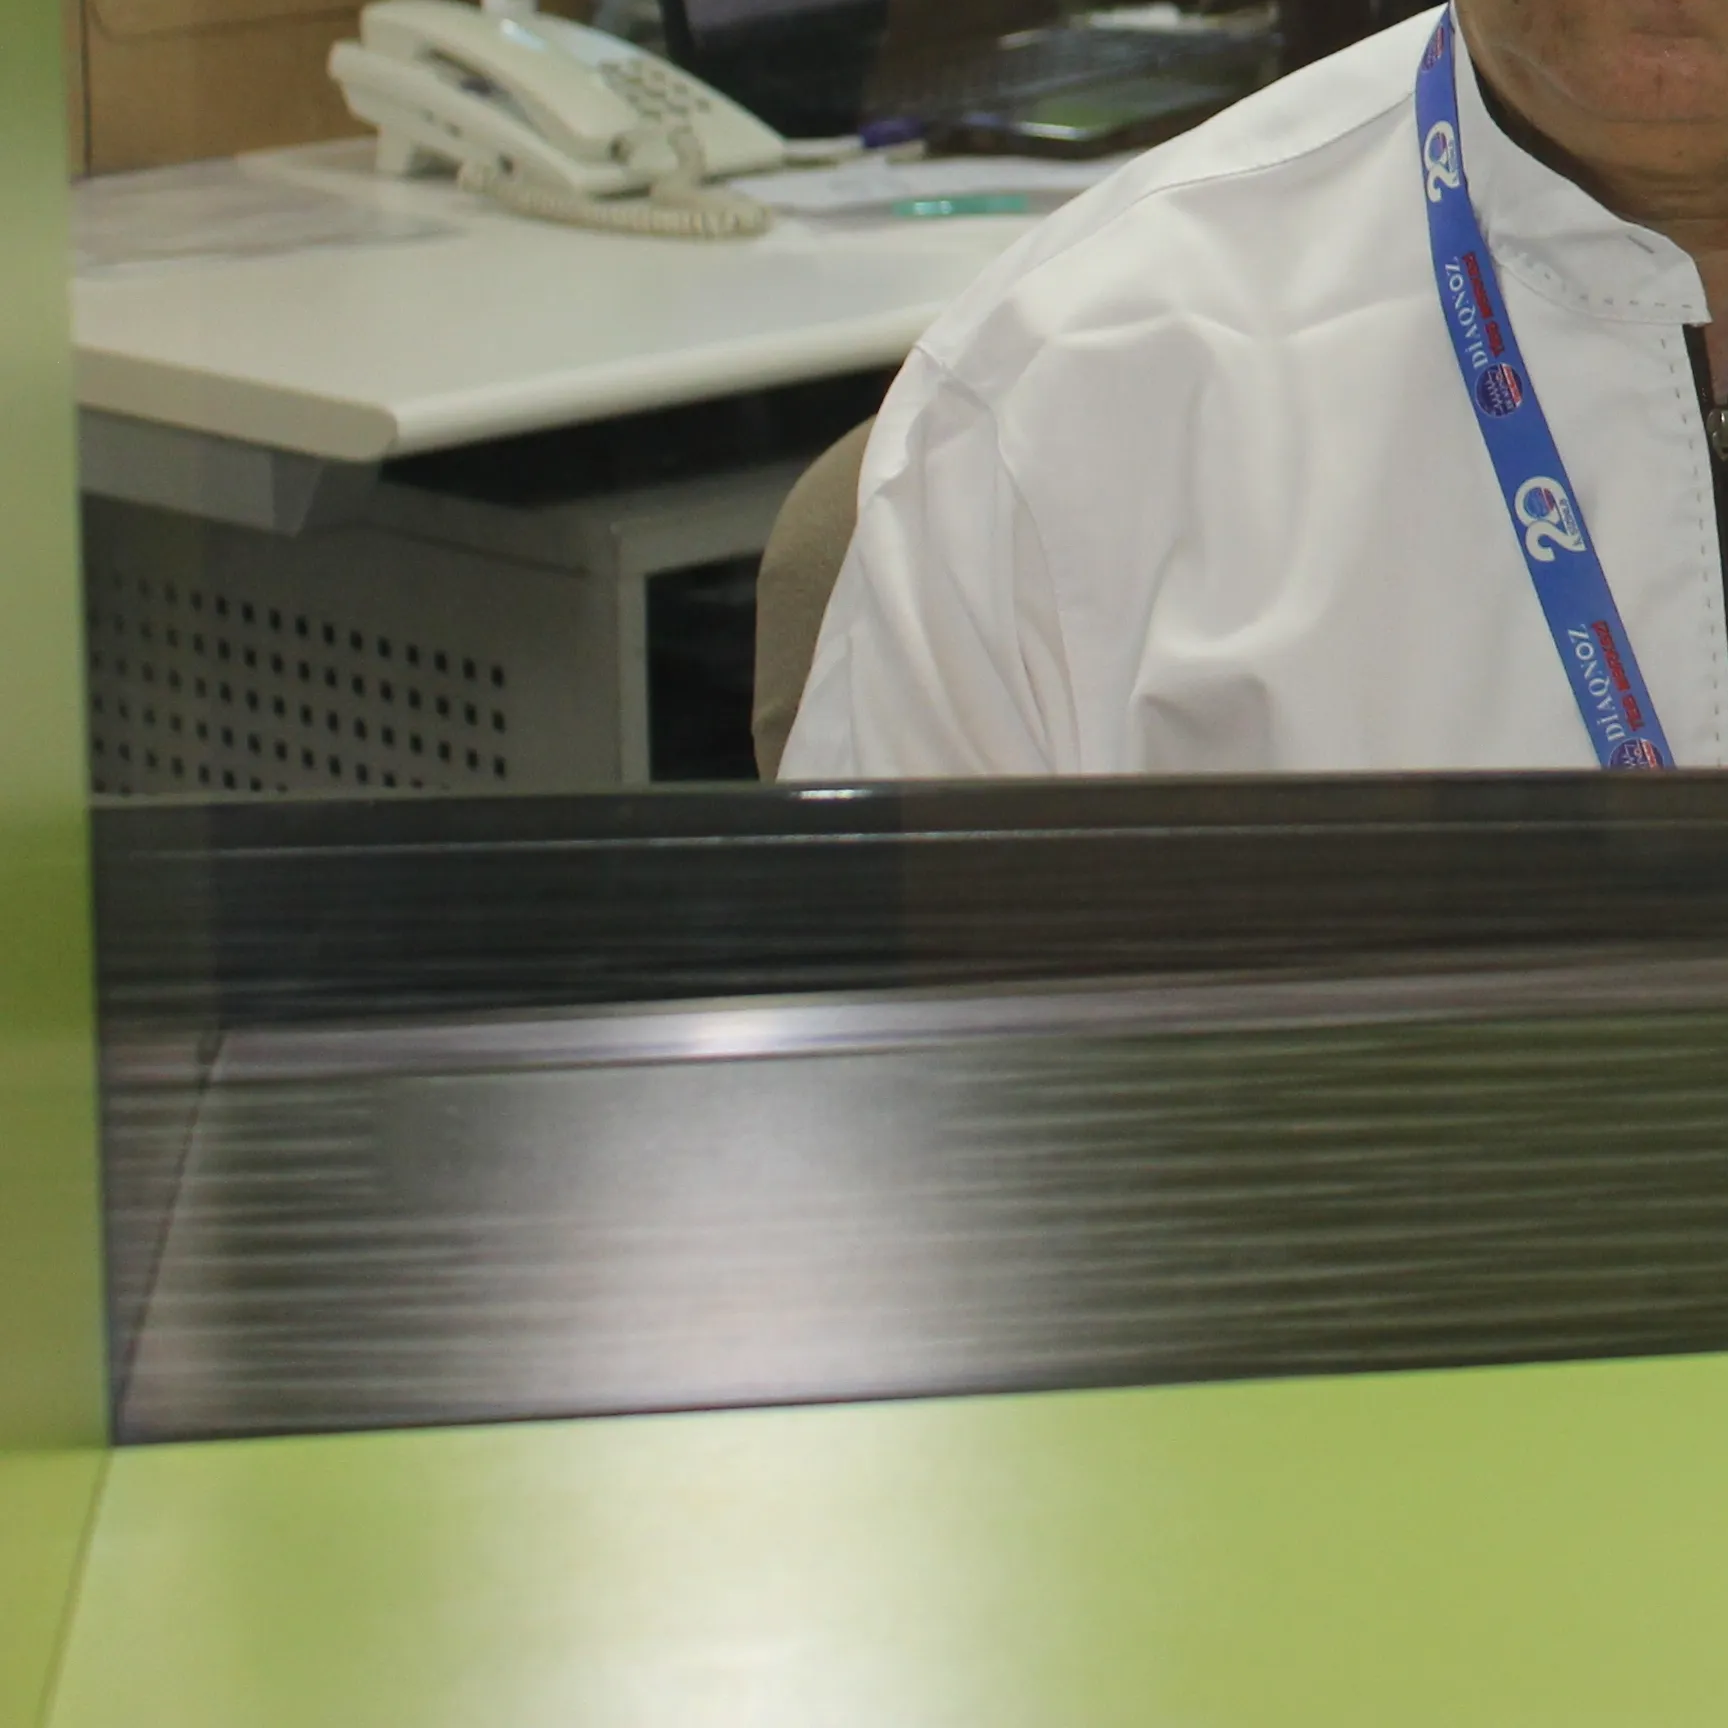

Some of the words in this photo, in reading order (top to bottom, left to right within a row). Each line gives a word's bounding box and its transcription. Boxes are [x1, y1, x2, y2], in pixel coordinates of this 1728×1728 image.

[1444, 254, 1489, 371] DİAQNOZ
[1513, 476, 1588, 563] 20
[1567, 622, 1627, 743] DİAQNOZ
